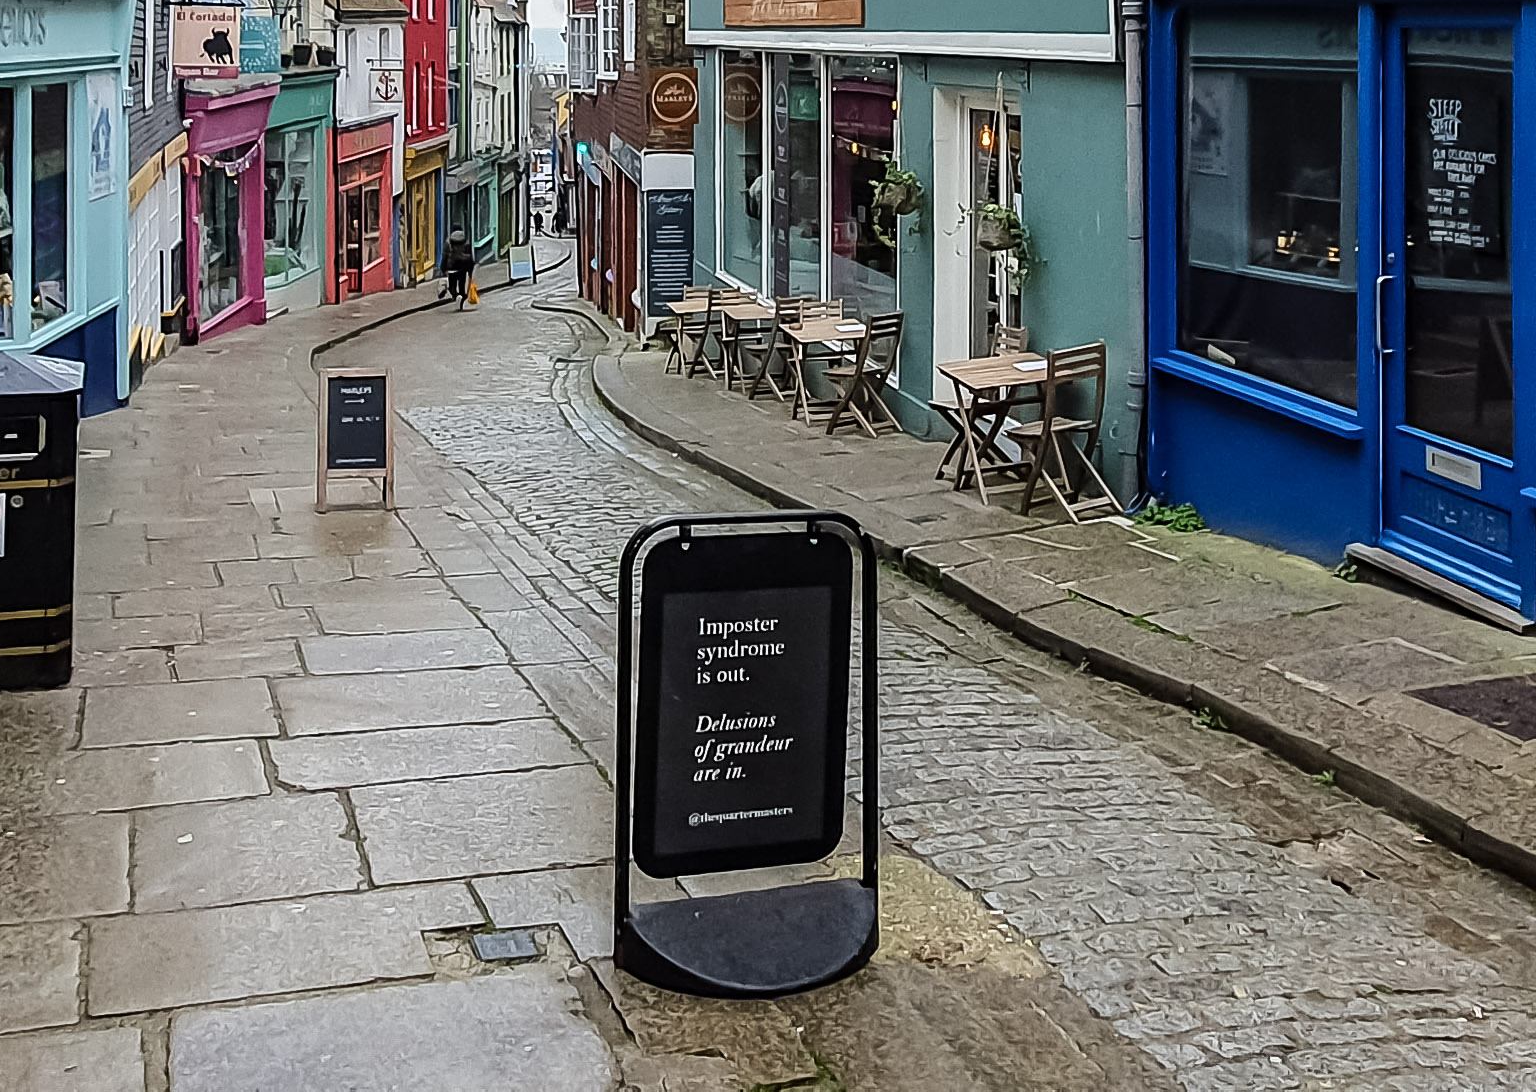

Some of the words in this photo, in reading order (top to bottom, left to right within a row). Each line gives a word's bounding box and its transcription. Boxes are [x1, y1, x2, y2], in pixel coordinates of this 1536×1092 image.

[1429, 98, 1462, 118] STEEP
[698, 616, 779, 640] Imposter
[696, 640, 785, 666] syndrome
[696, 666, 711, 685] is
[716, 666, 750, 684] out.
[695, 712, 777, 734] Delusions
[694, 738, 715, 763] of
[714, 735, 794, 761] grandeur
[693, 765, 720, 783] are
[725, 762, 747, 780] in.
[688, 804, 794, 827] @thequartermasters
